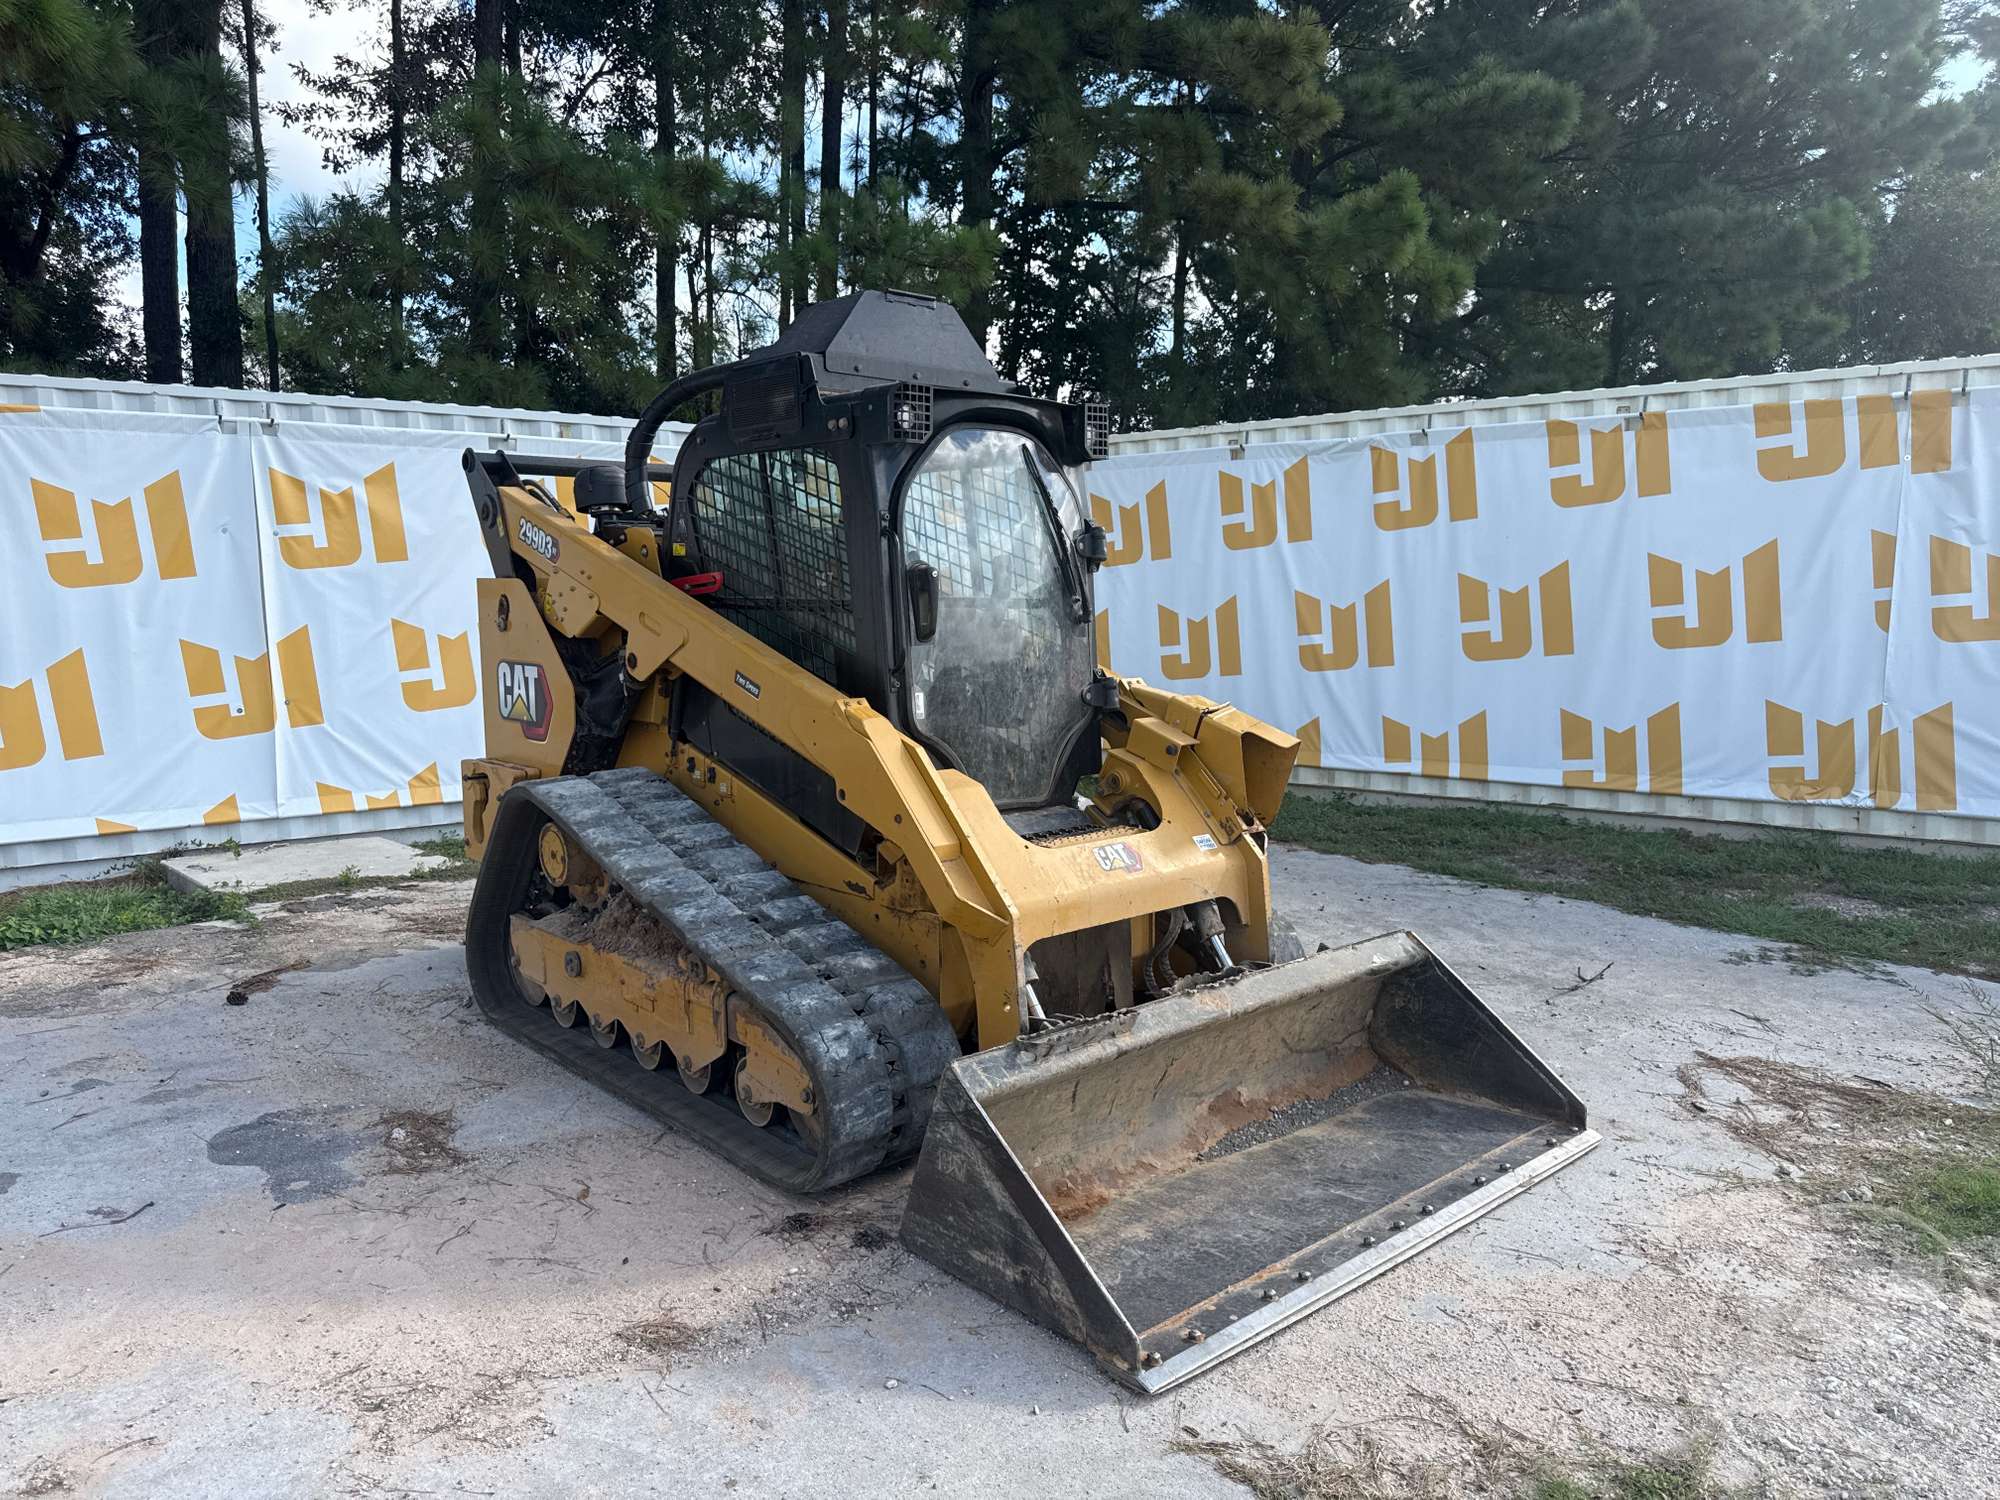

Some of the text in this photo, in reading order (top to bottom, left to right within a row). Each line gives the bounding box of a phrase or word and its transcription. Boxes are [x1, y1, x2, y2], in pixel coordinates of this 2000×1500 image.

[519, 517, 553, 559] 299D3
[498, 662, 538, 722] CAT
[1092, 843, 1132, 871] CAT
